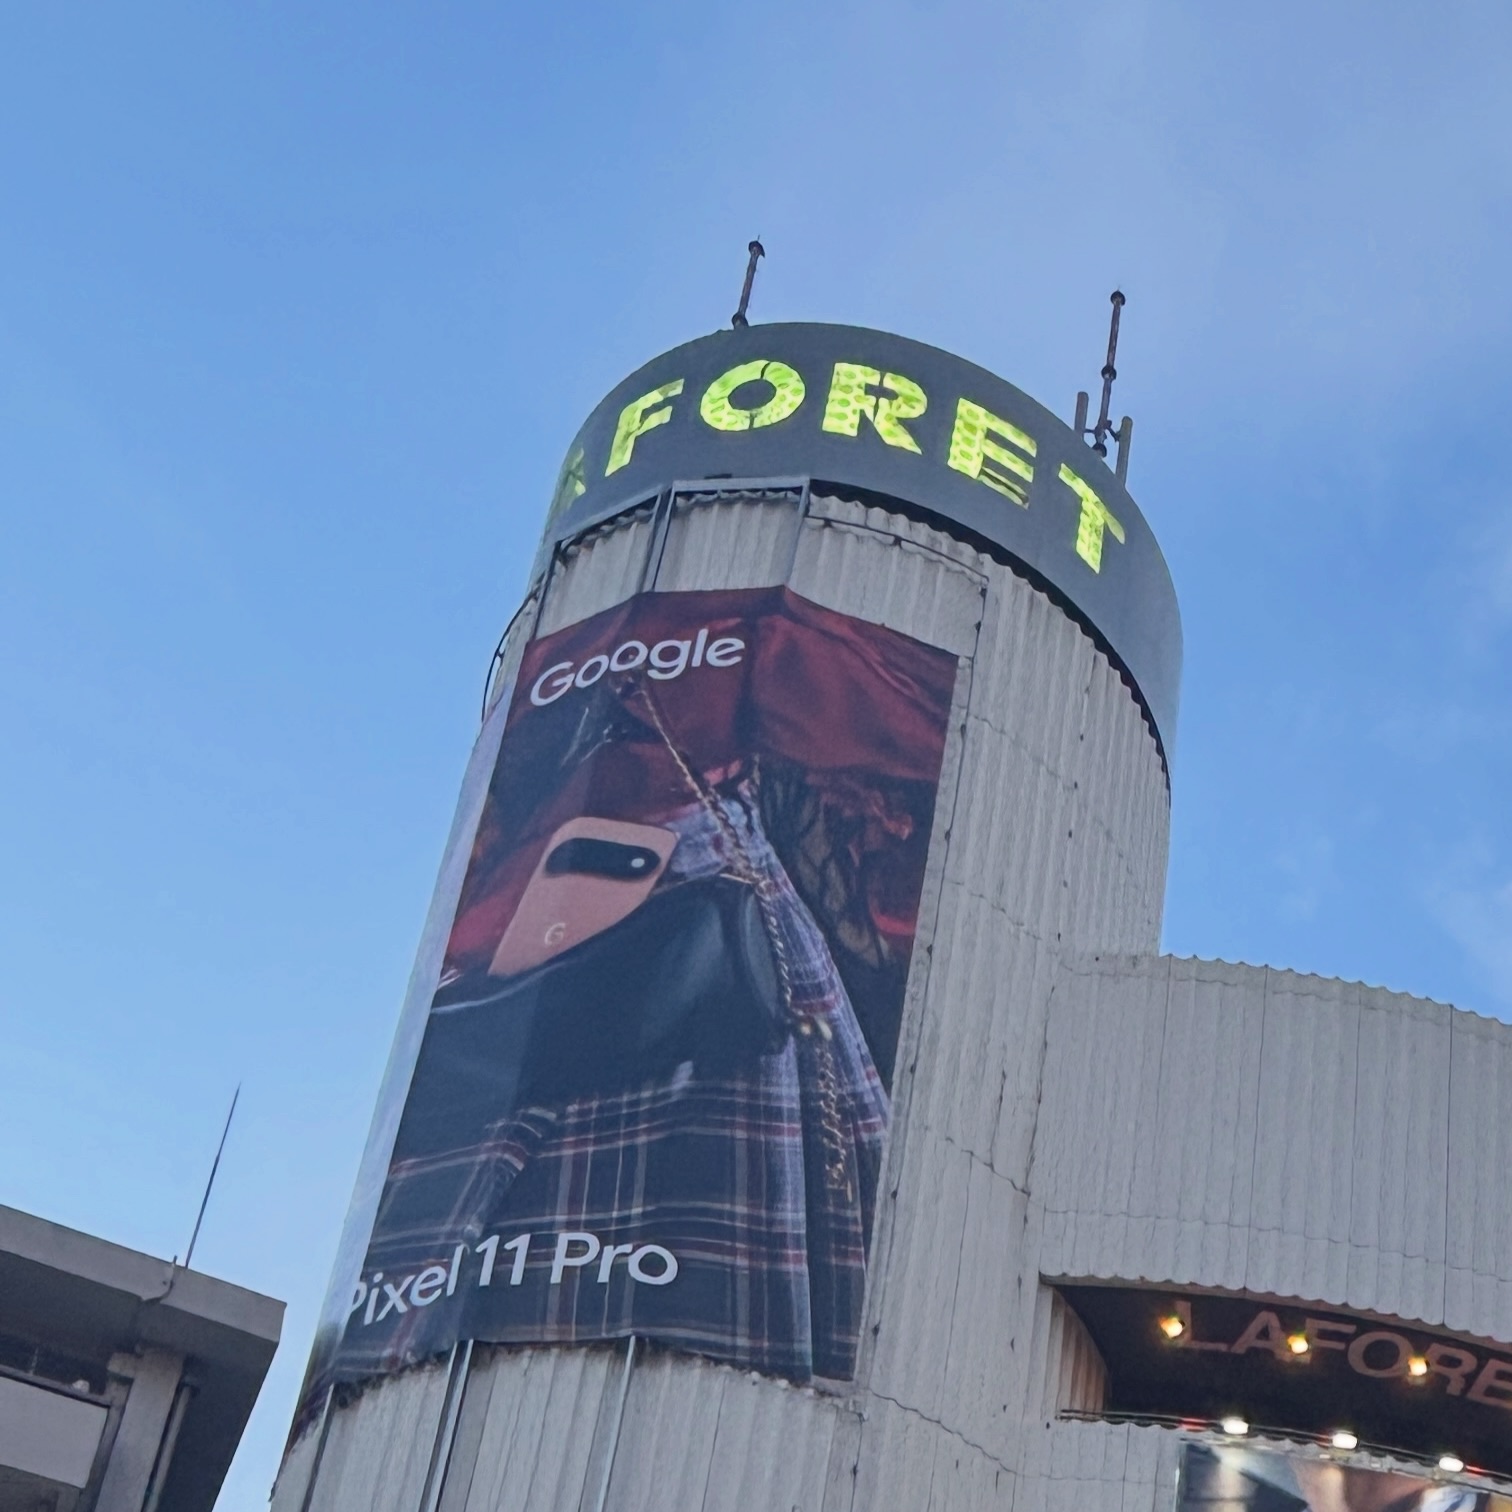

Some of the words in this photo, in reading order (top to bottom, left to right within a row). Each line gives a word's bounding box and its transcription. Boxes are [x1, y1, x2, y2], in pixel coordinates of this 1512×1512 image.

[531, 629, 745, 708] Google
[475, 1233, 529, 1287] 11
[550, 1232, 679, 1285] Pro
